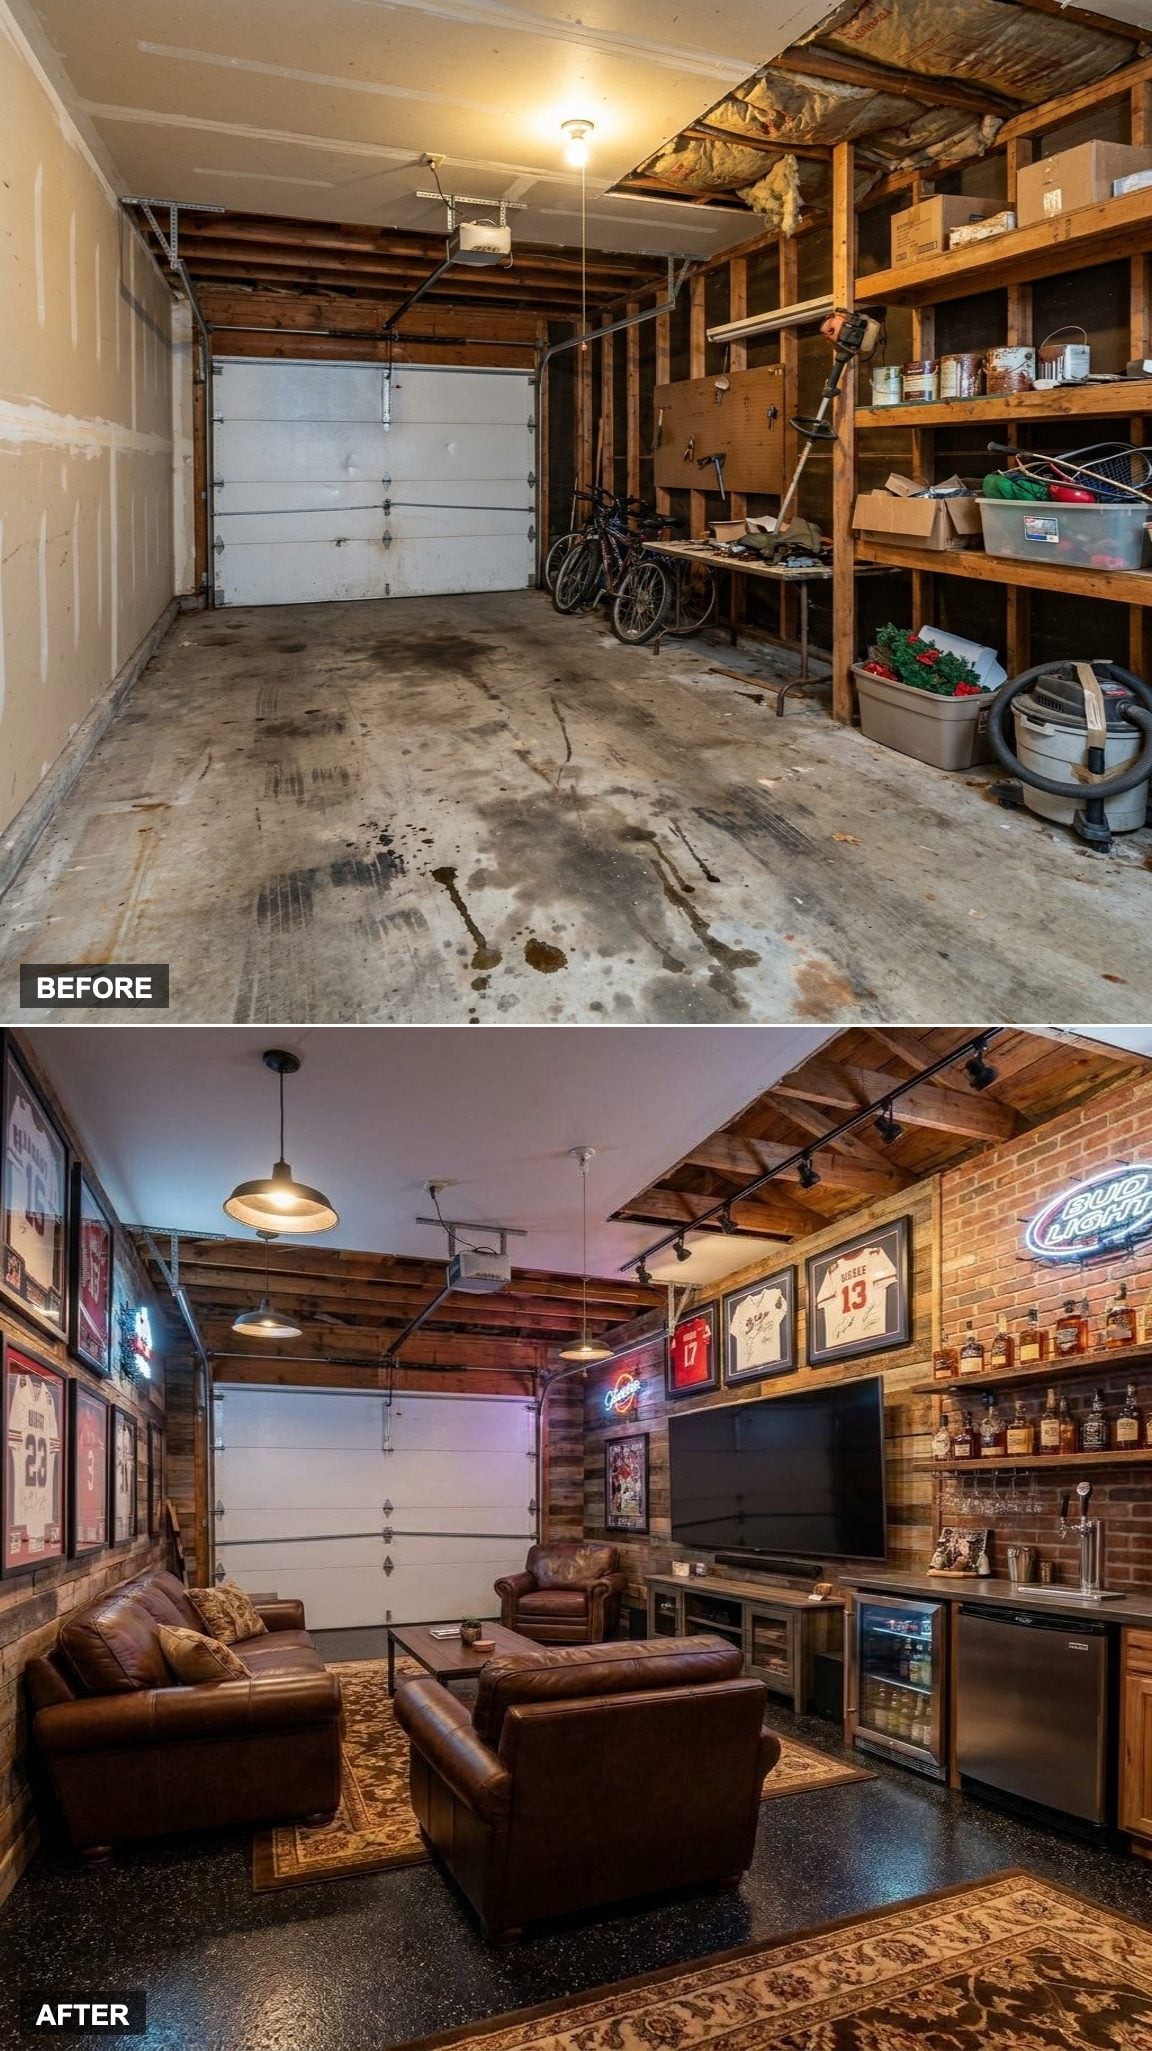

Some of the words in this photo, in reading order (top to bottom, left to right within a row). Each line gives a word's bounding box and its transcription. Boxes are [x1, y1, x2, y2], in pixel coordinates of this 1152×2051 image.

[1044, 1191, 1152, 1246] LIGHT
[1061, 1173, 1149, 1220] BUD
[842, 1280, 867, 1314] 13
[684, 1341, 698, 1368] 17
[25, 1433, 47, 1488] 23
